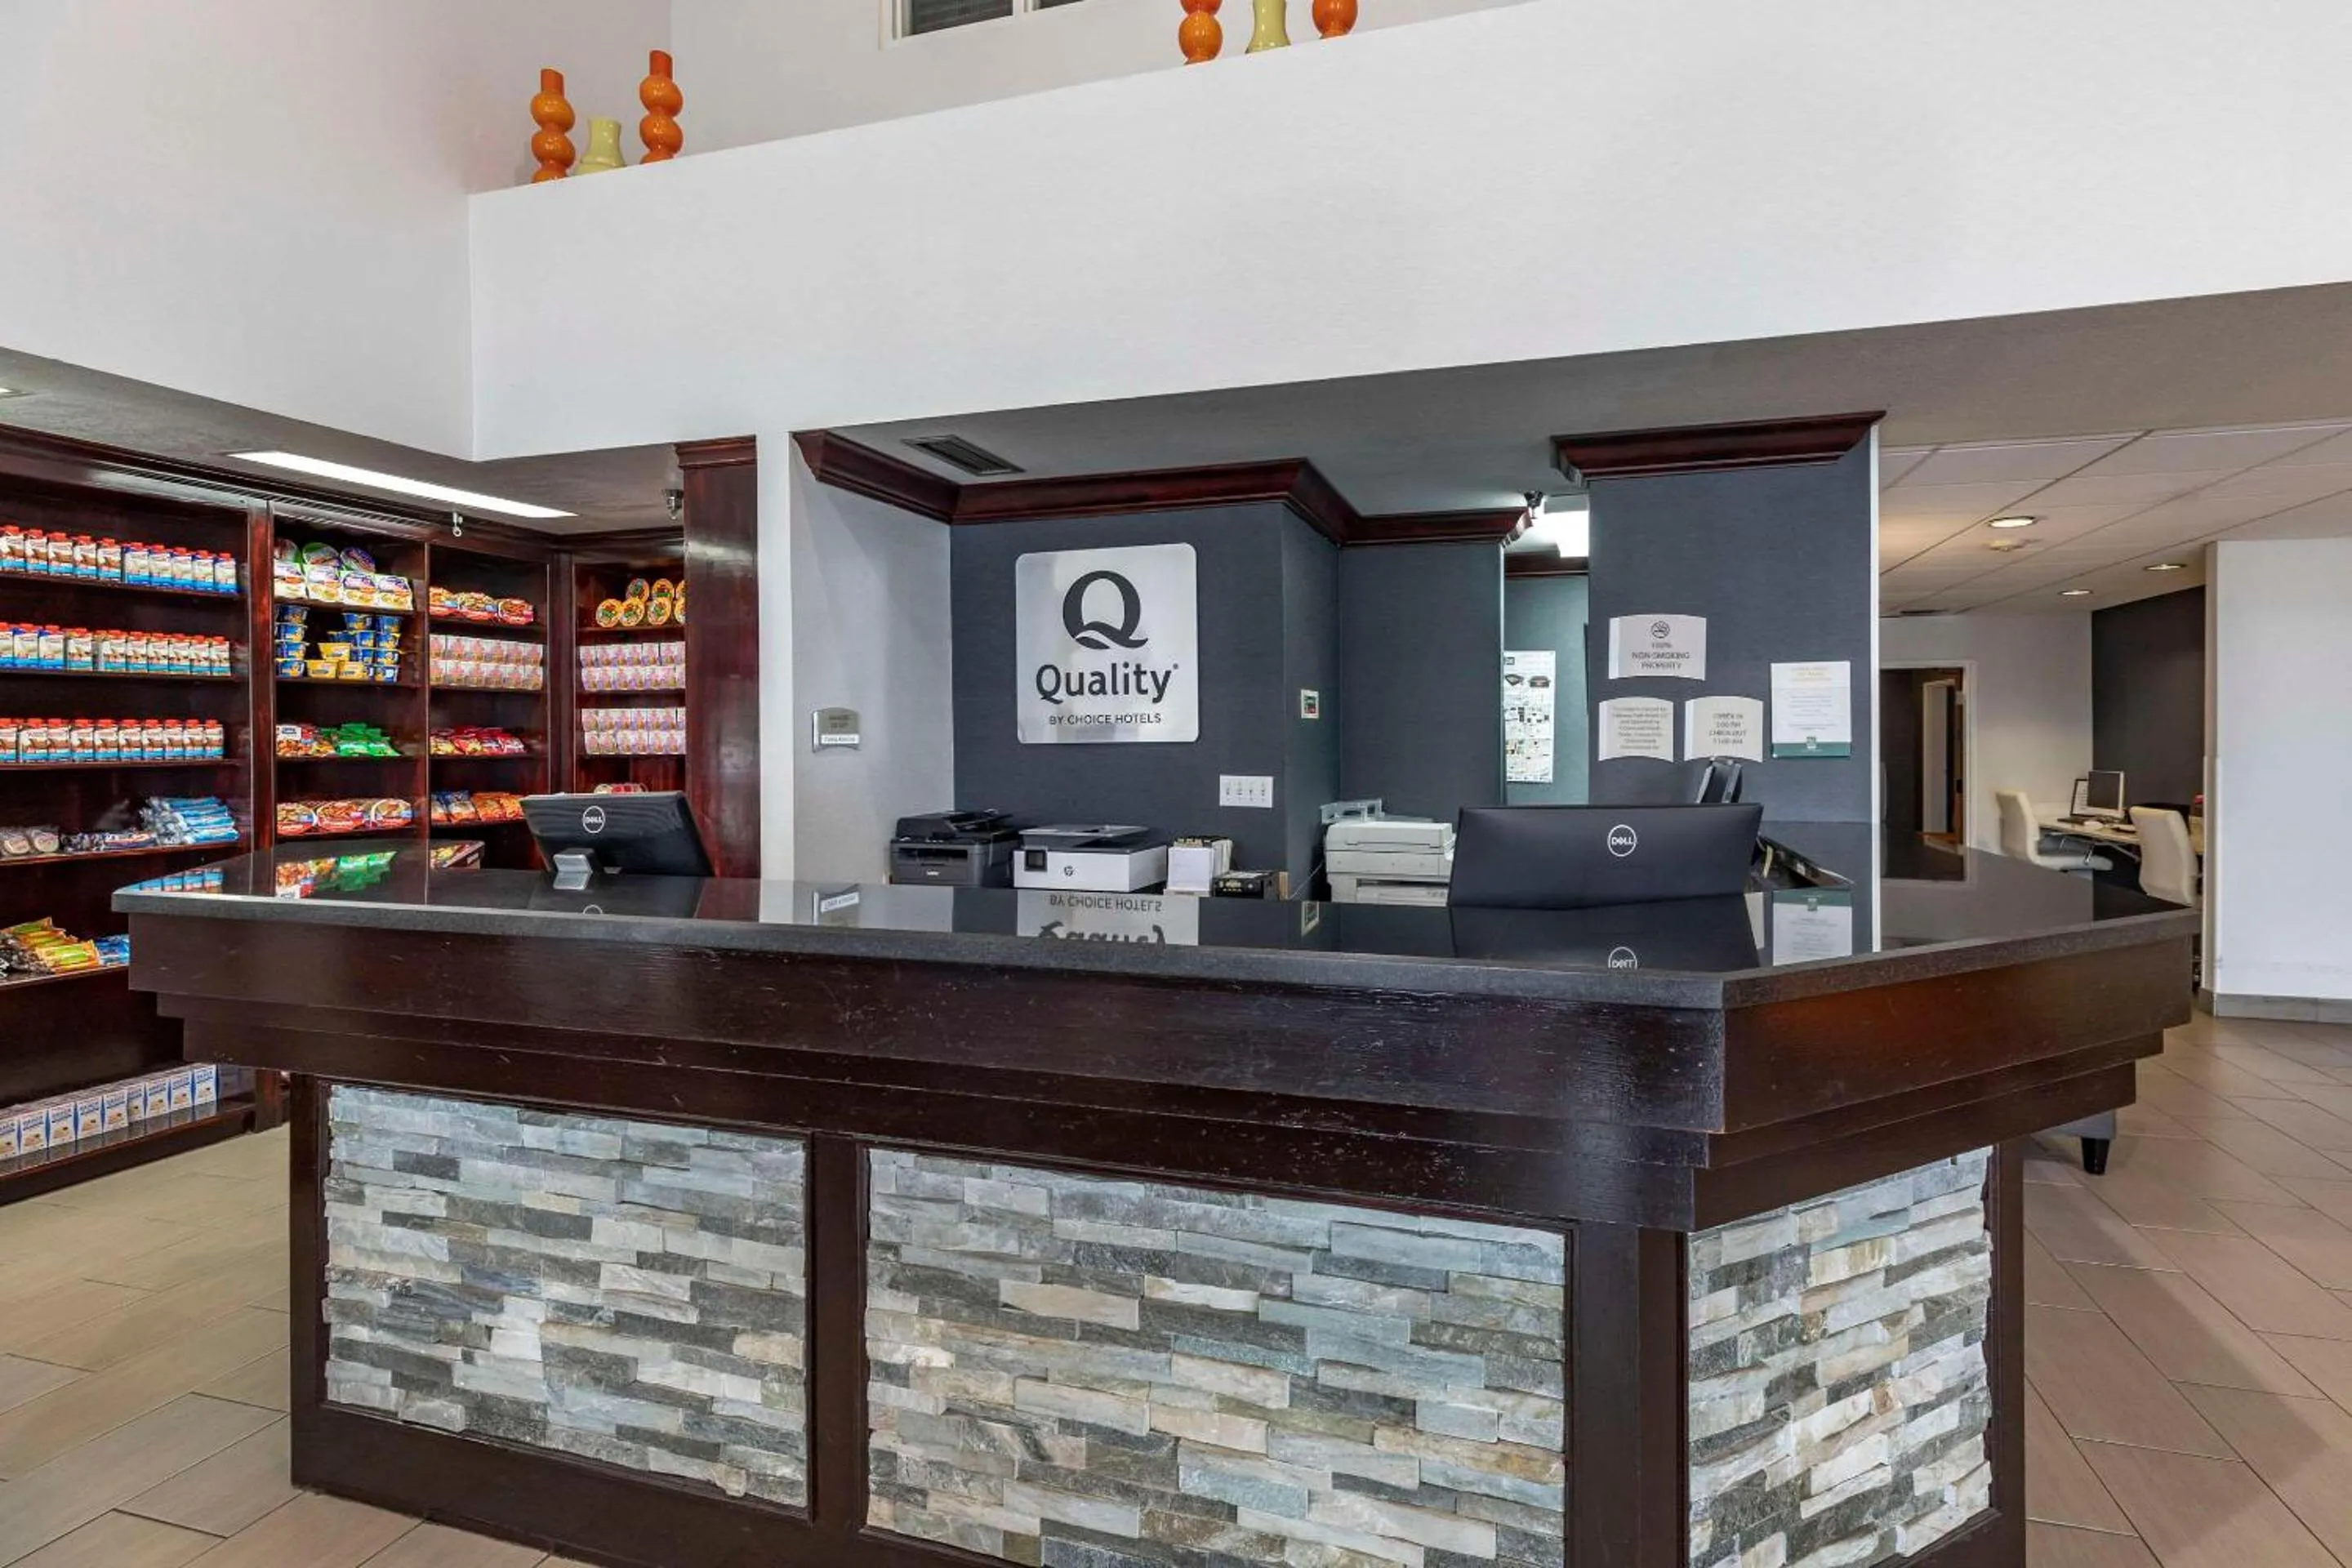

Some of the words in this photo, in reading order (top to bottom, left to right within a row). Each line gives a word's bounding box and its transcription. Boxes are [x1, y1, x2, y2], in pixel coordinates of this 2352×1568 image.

[1062, 570, 1148, 649] Q
[1036, 662, 1172, 705] Quality
[1049, 715, 1064, 725] BY
[1067, 714, 1111, 725] CHOICE
[1116, 713, 1161, 724] HOTELS
[1611, 836, 1634, 845] DELL
